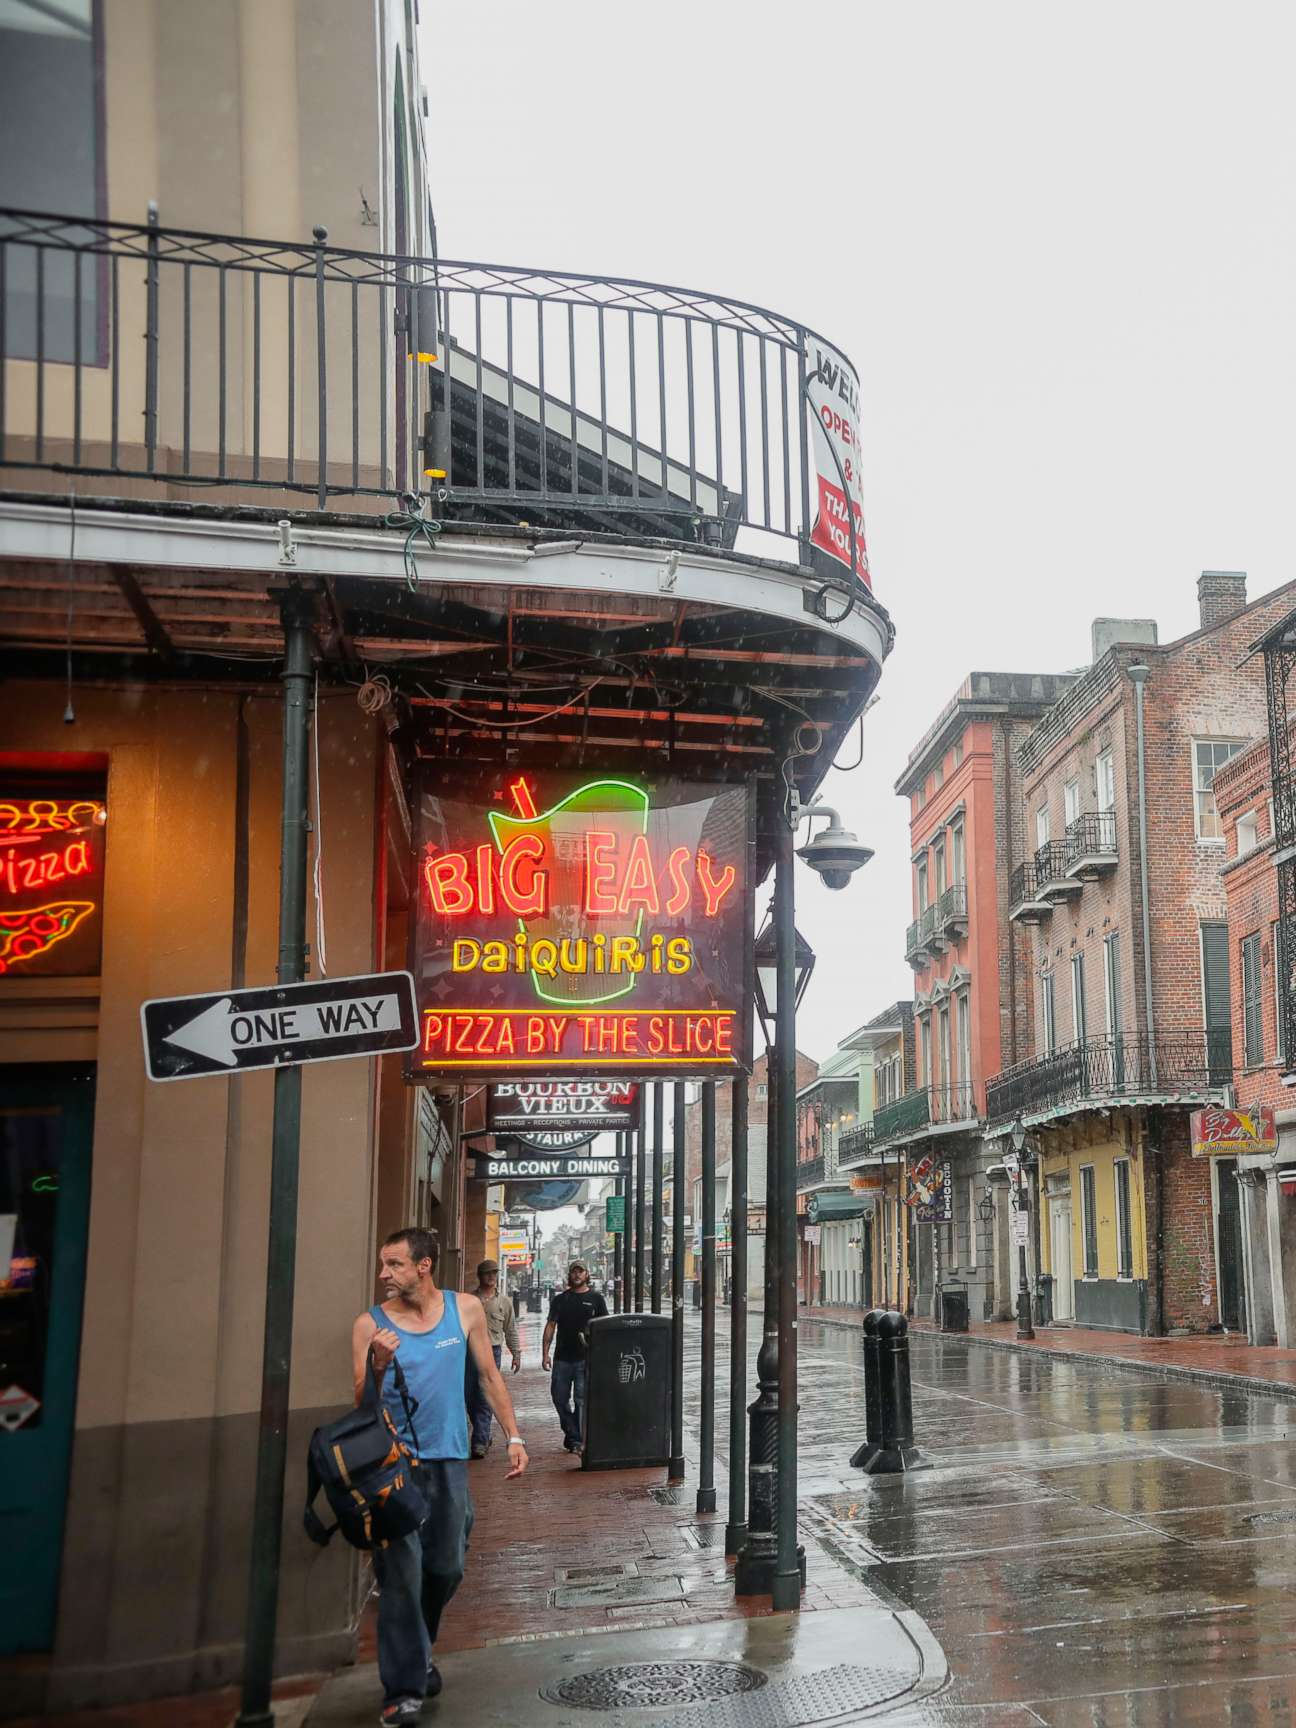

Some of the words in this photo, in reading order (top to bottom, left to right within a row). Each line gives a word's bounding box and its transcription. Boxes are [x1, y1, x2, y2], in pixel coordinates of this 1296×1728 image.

[0, 840, 89, 894] izza
[424, 834, 545, 915] BIG
[586, 831, 736, 917] EASY
[230, 1010, 300, 1045] ONE
[316, 999, 385, 1034] WAY
[424, 1015, 515, 1054] PIZZA
[527, 1016, 568, 1053] BY
[577, 1016, 638, 1053] THE
[647, 1015, 732, 1053] SLICE
[494, 1082, 632, 1097] BOURBON
[518, 1096, 610, 1114] VIEUX
[487, 1160, 561, 1175] BALCONY
[567, 1159, 620, 1174] DINING
